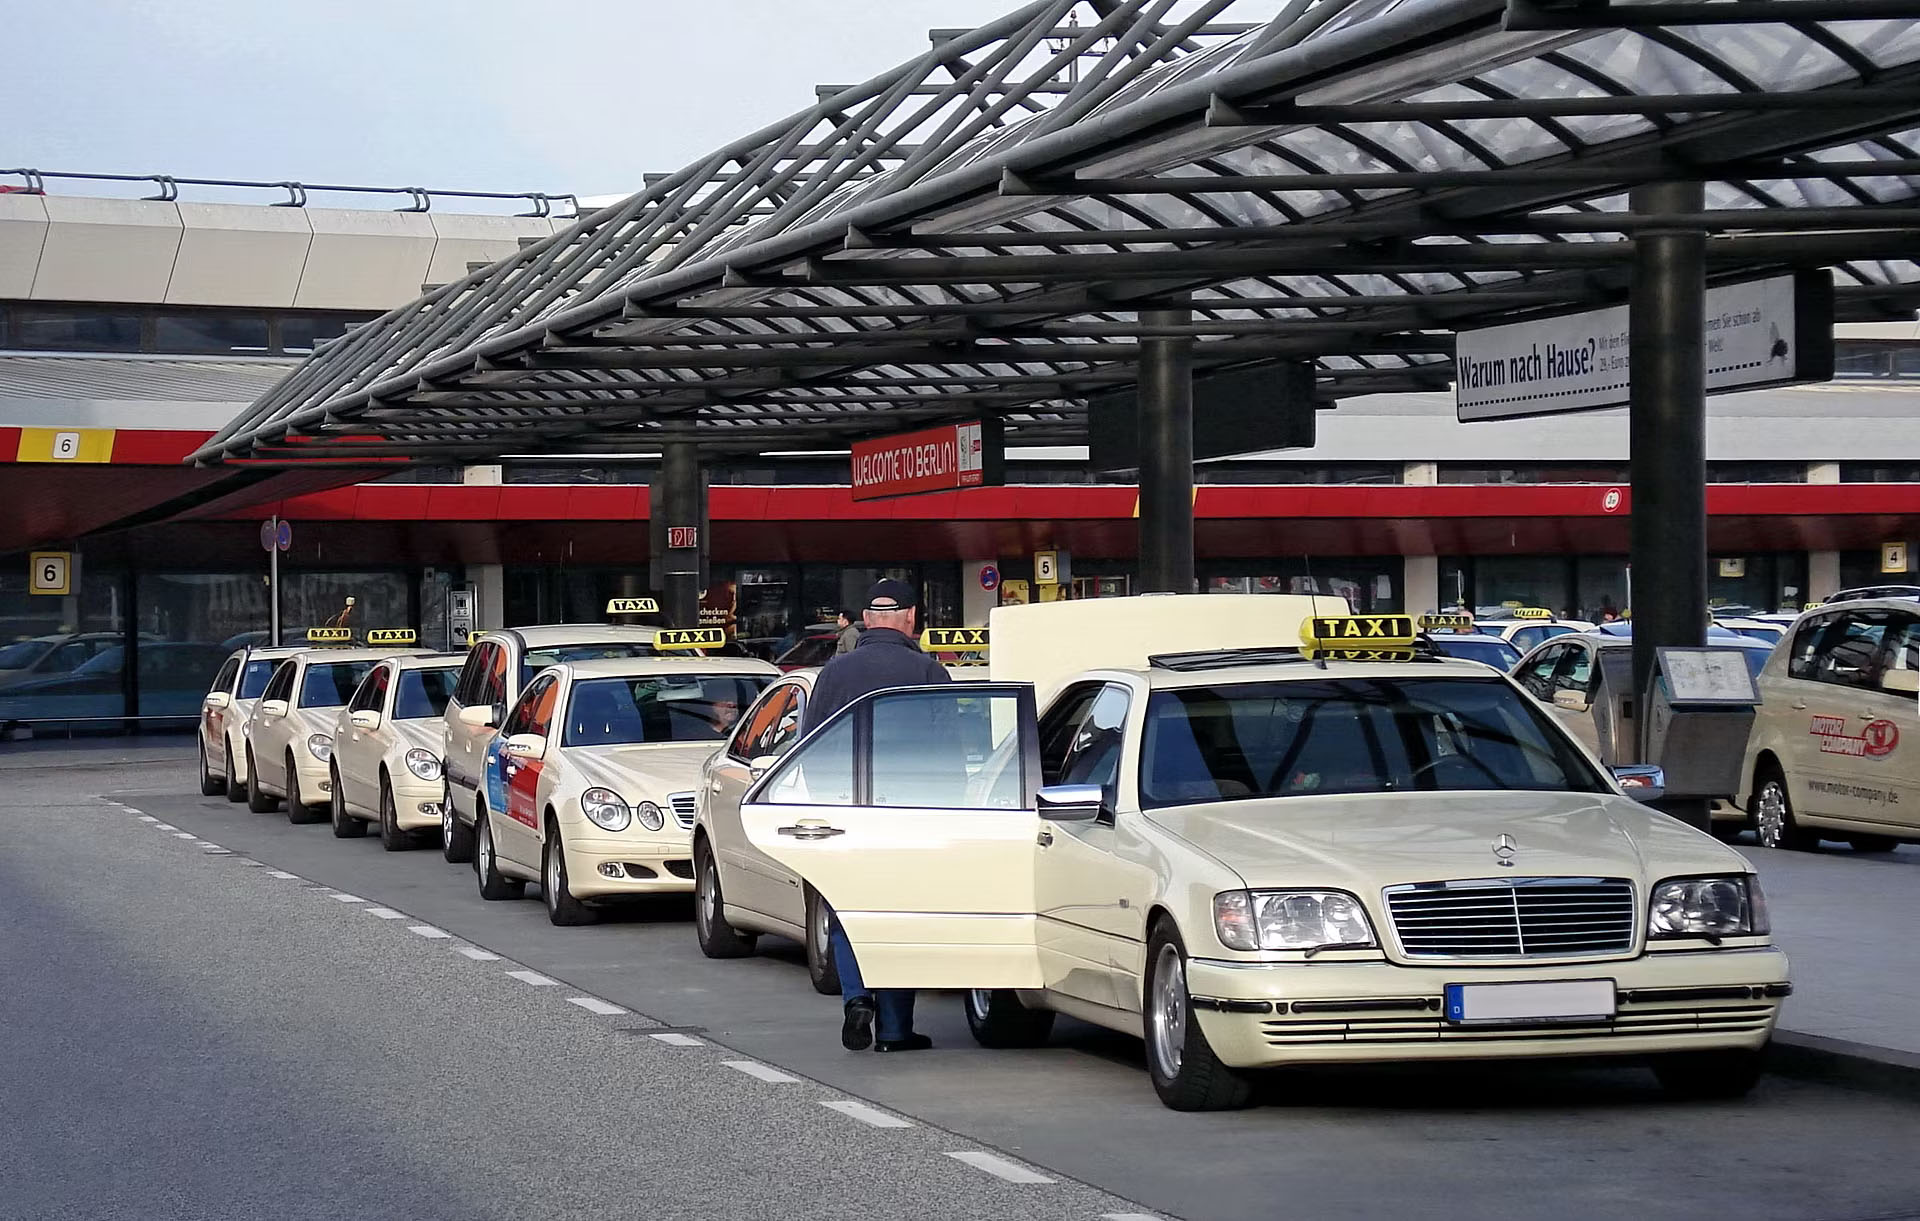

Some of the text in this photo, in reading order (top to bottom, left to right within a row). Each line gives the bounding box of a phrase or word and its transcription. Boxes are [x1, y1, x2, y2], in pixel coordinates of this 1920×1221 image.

[1459, 337, 1595, 390] Warum nach Hause?
[61, 438, 71, 453] 6
[853, 449, 900, 488] WELCOME
[901, 447, 914, 480] TO
[916, 441, 956, 478] BERLIN!
[1890, 551, 1897, 563] 4
[44, 564, 56, 582] 6
[1042, 561, 1050, 574] 5
[616, 600, 653, 611] TAXI
[1429, 616, 1465, 625] TAXI
[316, 629, 345, 638] TAXI
[1324, 619, 1399, 637] TAXI
[377, 630, 409, 640] TAXI
[667, 630, 715, 643] TAXI
[937, 630, 984, 644] TAX
[1811, 716, 1843, 736] MOTOR
[1453, 1006, 1460, 1014] D
